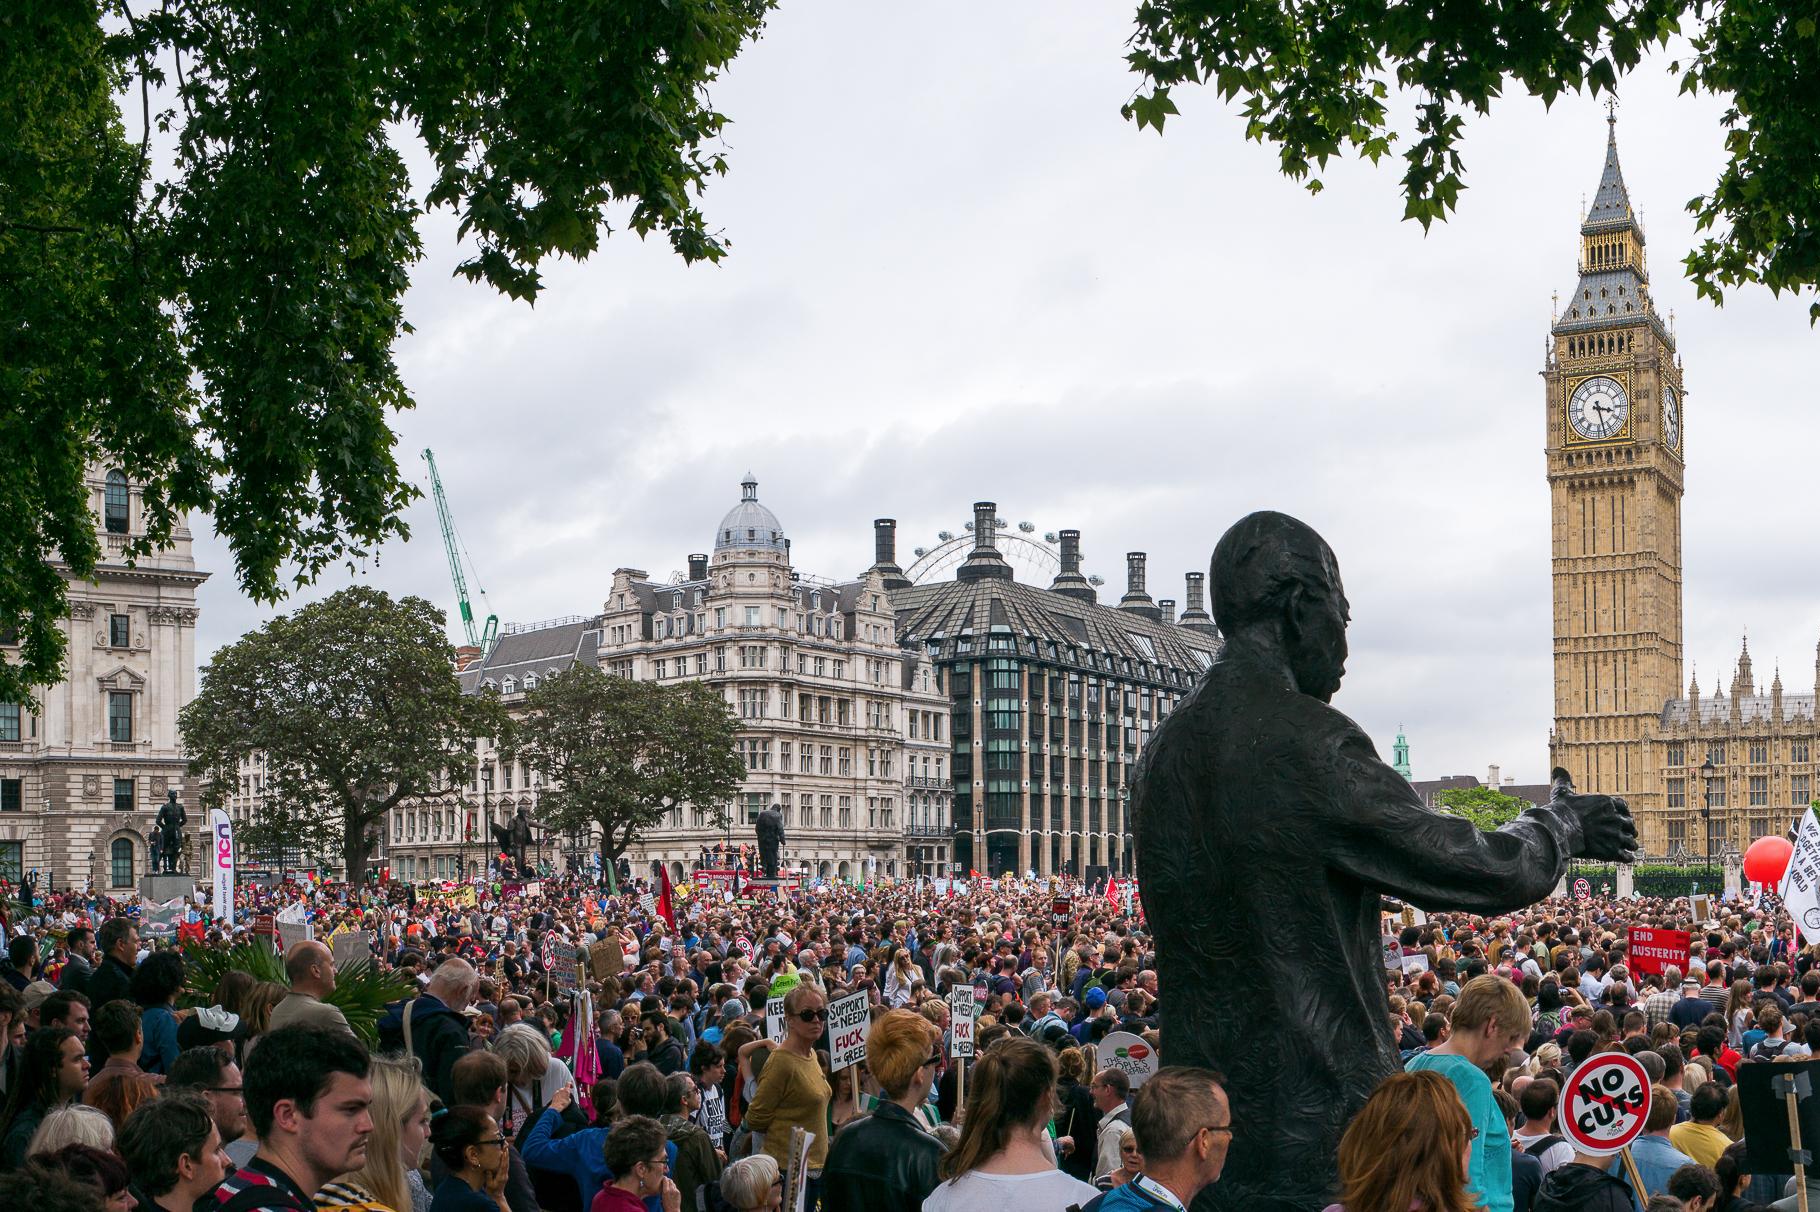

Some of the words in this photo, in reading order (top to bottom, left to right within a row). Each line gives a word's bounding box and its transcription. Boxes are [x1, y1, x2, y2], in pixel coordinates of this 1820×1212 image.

[1805, 822, 1819, 838] WE
[1052, 912, 1068, 922] Out!
[1633, 930, 1653, 941] END
[1632, 945, 1686, 960] AUSTERITY
[954, 986, 972, 1002] SUPPORT
[768, 1002, 784, 1017] KEE
[830, 996, 866, 1020] SUPPORT
[958, 1003, 973, 1017] NEEDY
[830, 1020, 839, 1030] THE
[840, 1009, 869, 1028] NEEDY
[955, 1022, 970, 1038] FUCK
[835, 1028, 864, 1052] FUCK
[1103, 1060, 1149, 1070] OPLE'S
[1105, 1057, 1120, 1065] THE
[1578, 1068, 1624, 1106] NO
[1578, 1085, 1644, 1134] CUTS
